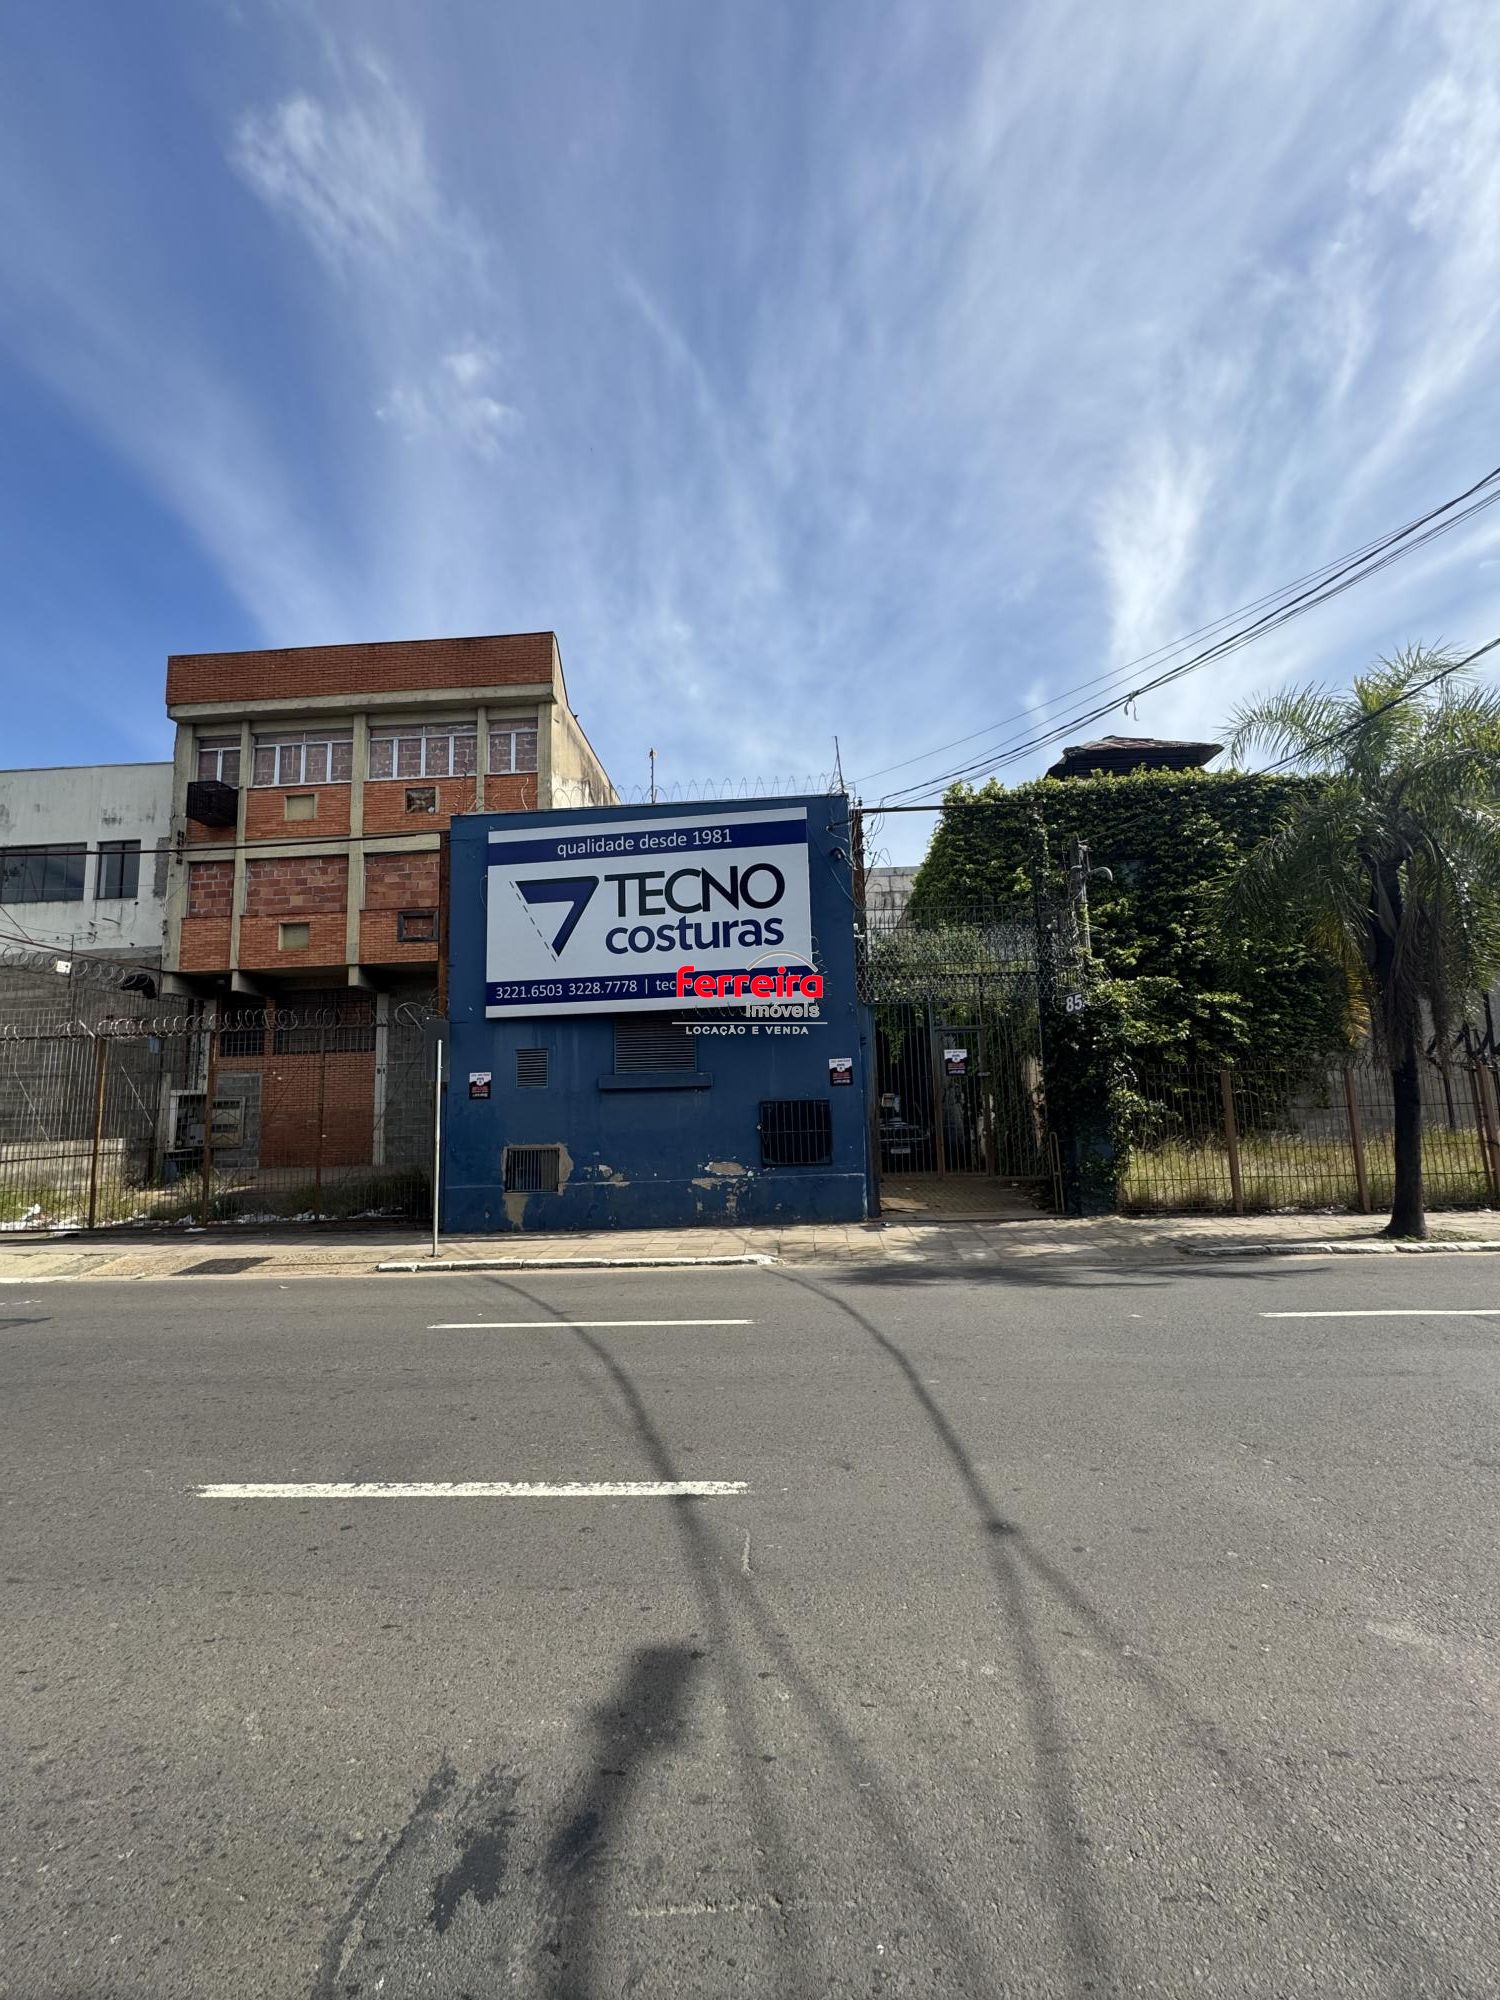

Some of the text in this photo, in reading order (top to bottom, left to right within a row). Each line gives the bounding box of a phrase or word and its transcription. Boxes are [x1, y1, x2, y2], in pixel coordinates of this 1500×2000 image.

[557, 828, 732, 857] qualidade desde 1981
[604, 863, 786, 917] TECNO
[605, 915, 785, 955] costuras
[495, 984, 563, 999] 3221.6503
[568, 980, 638, 995] 3228.7778
